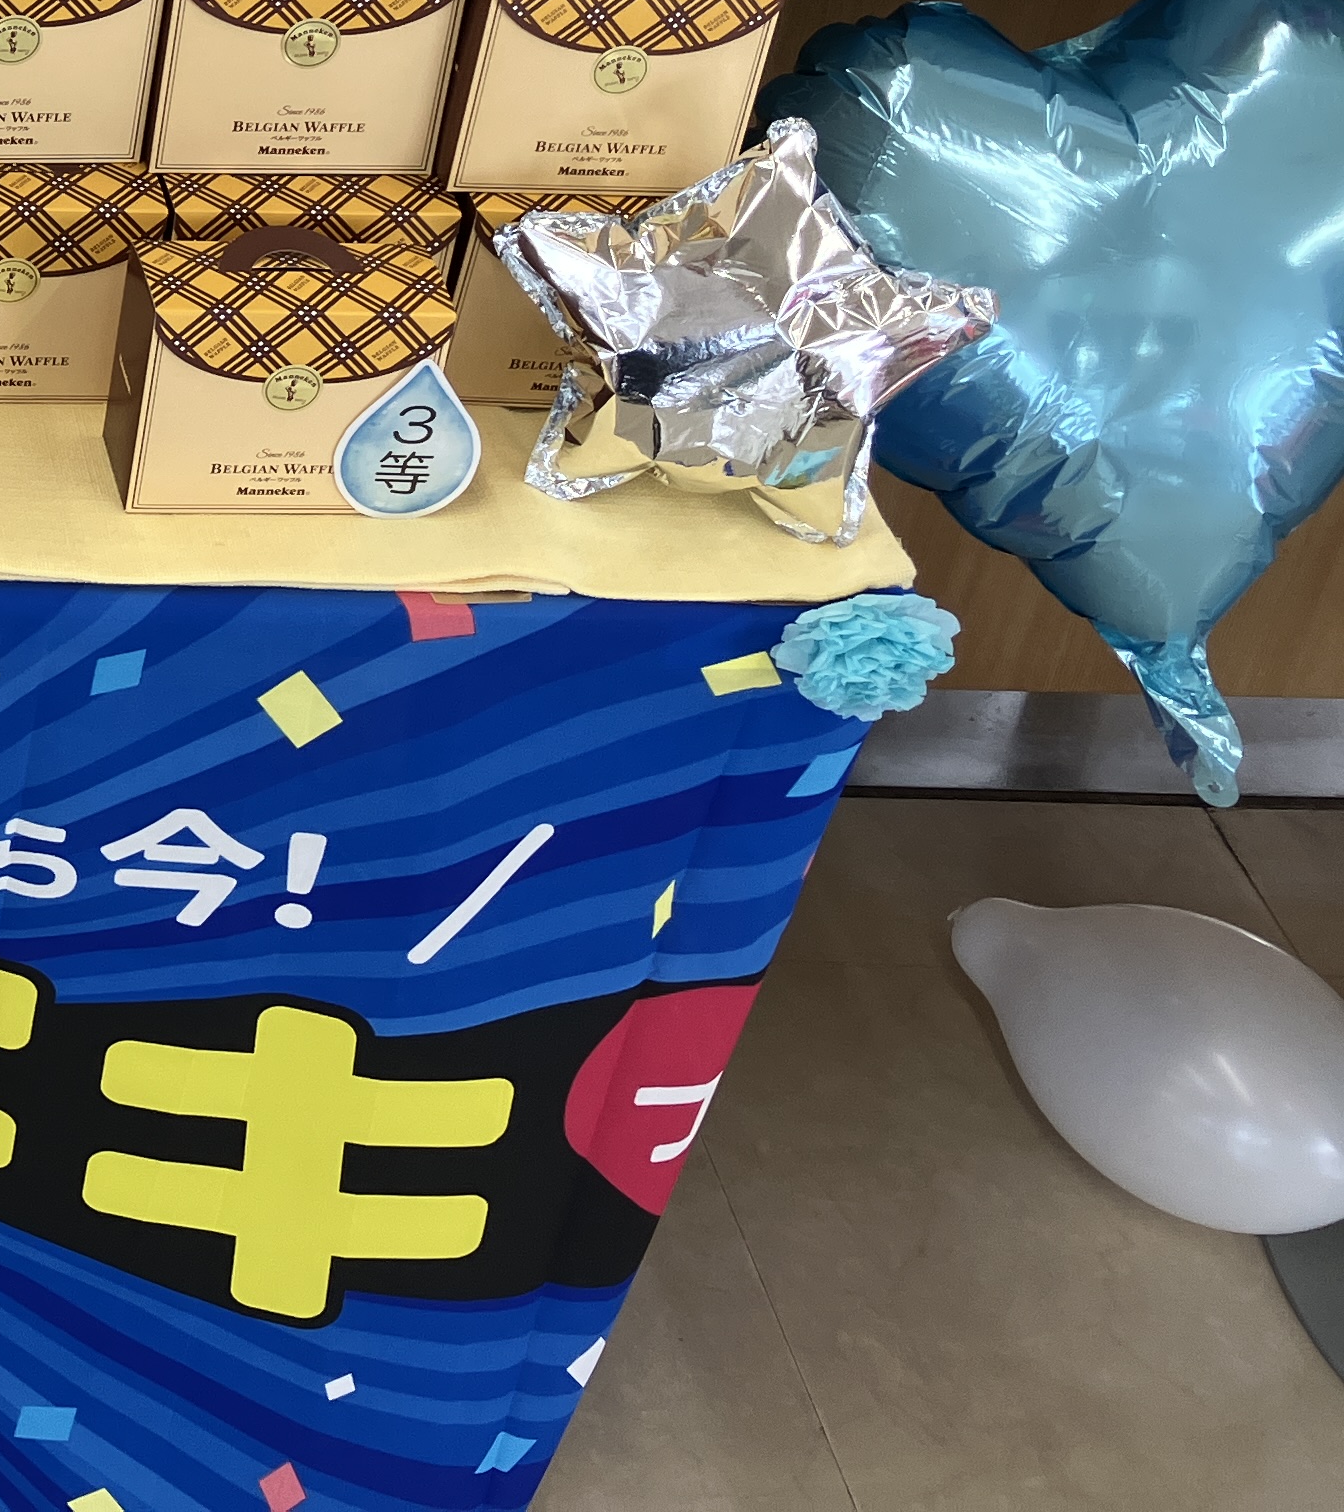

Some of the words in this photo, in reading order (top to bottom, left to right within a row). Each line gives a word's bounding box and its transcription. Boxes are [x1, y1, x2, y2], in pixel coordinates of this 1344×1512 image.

[11, 112, 72, 123] WAFFLE
[232, 121, 300, 133] BELGIAN
[304, 121, 366, 133] WAFFLE
[258, 146, 326, 155] Manneken
[535, 140, 602, 154] BELGIAN
[607, 142, 667, 155] WAFFLE
[557, 166, 625, 177] Manneken
[10, 355, 70, 366] WAFFLE
[508, 359, 574, 370] BELGIA
[375, 406, 437, 495] 3等
[210, 463, 278, 475] BELGIAN
[236, 486, 306, 496] Manneken
